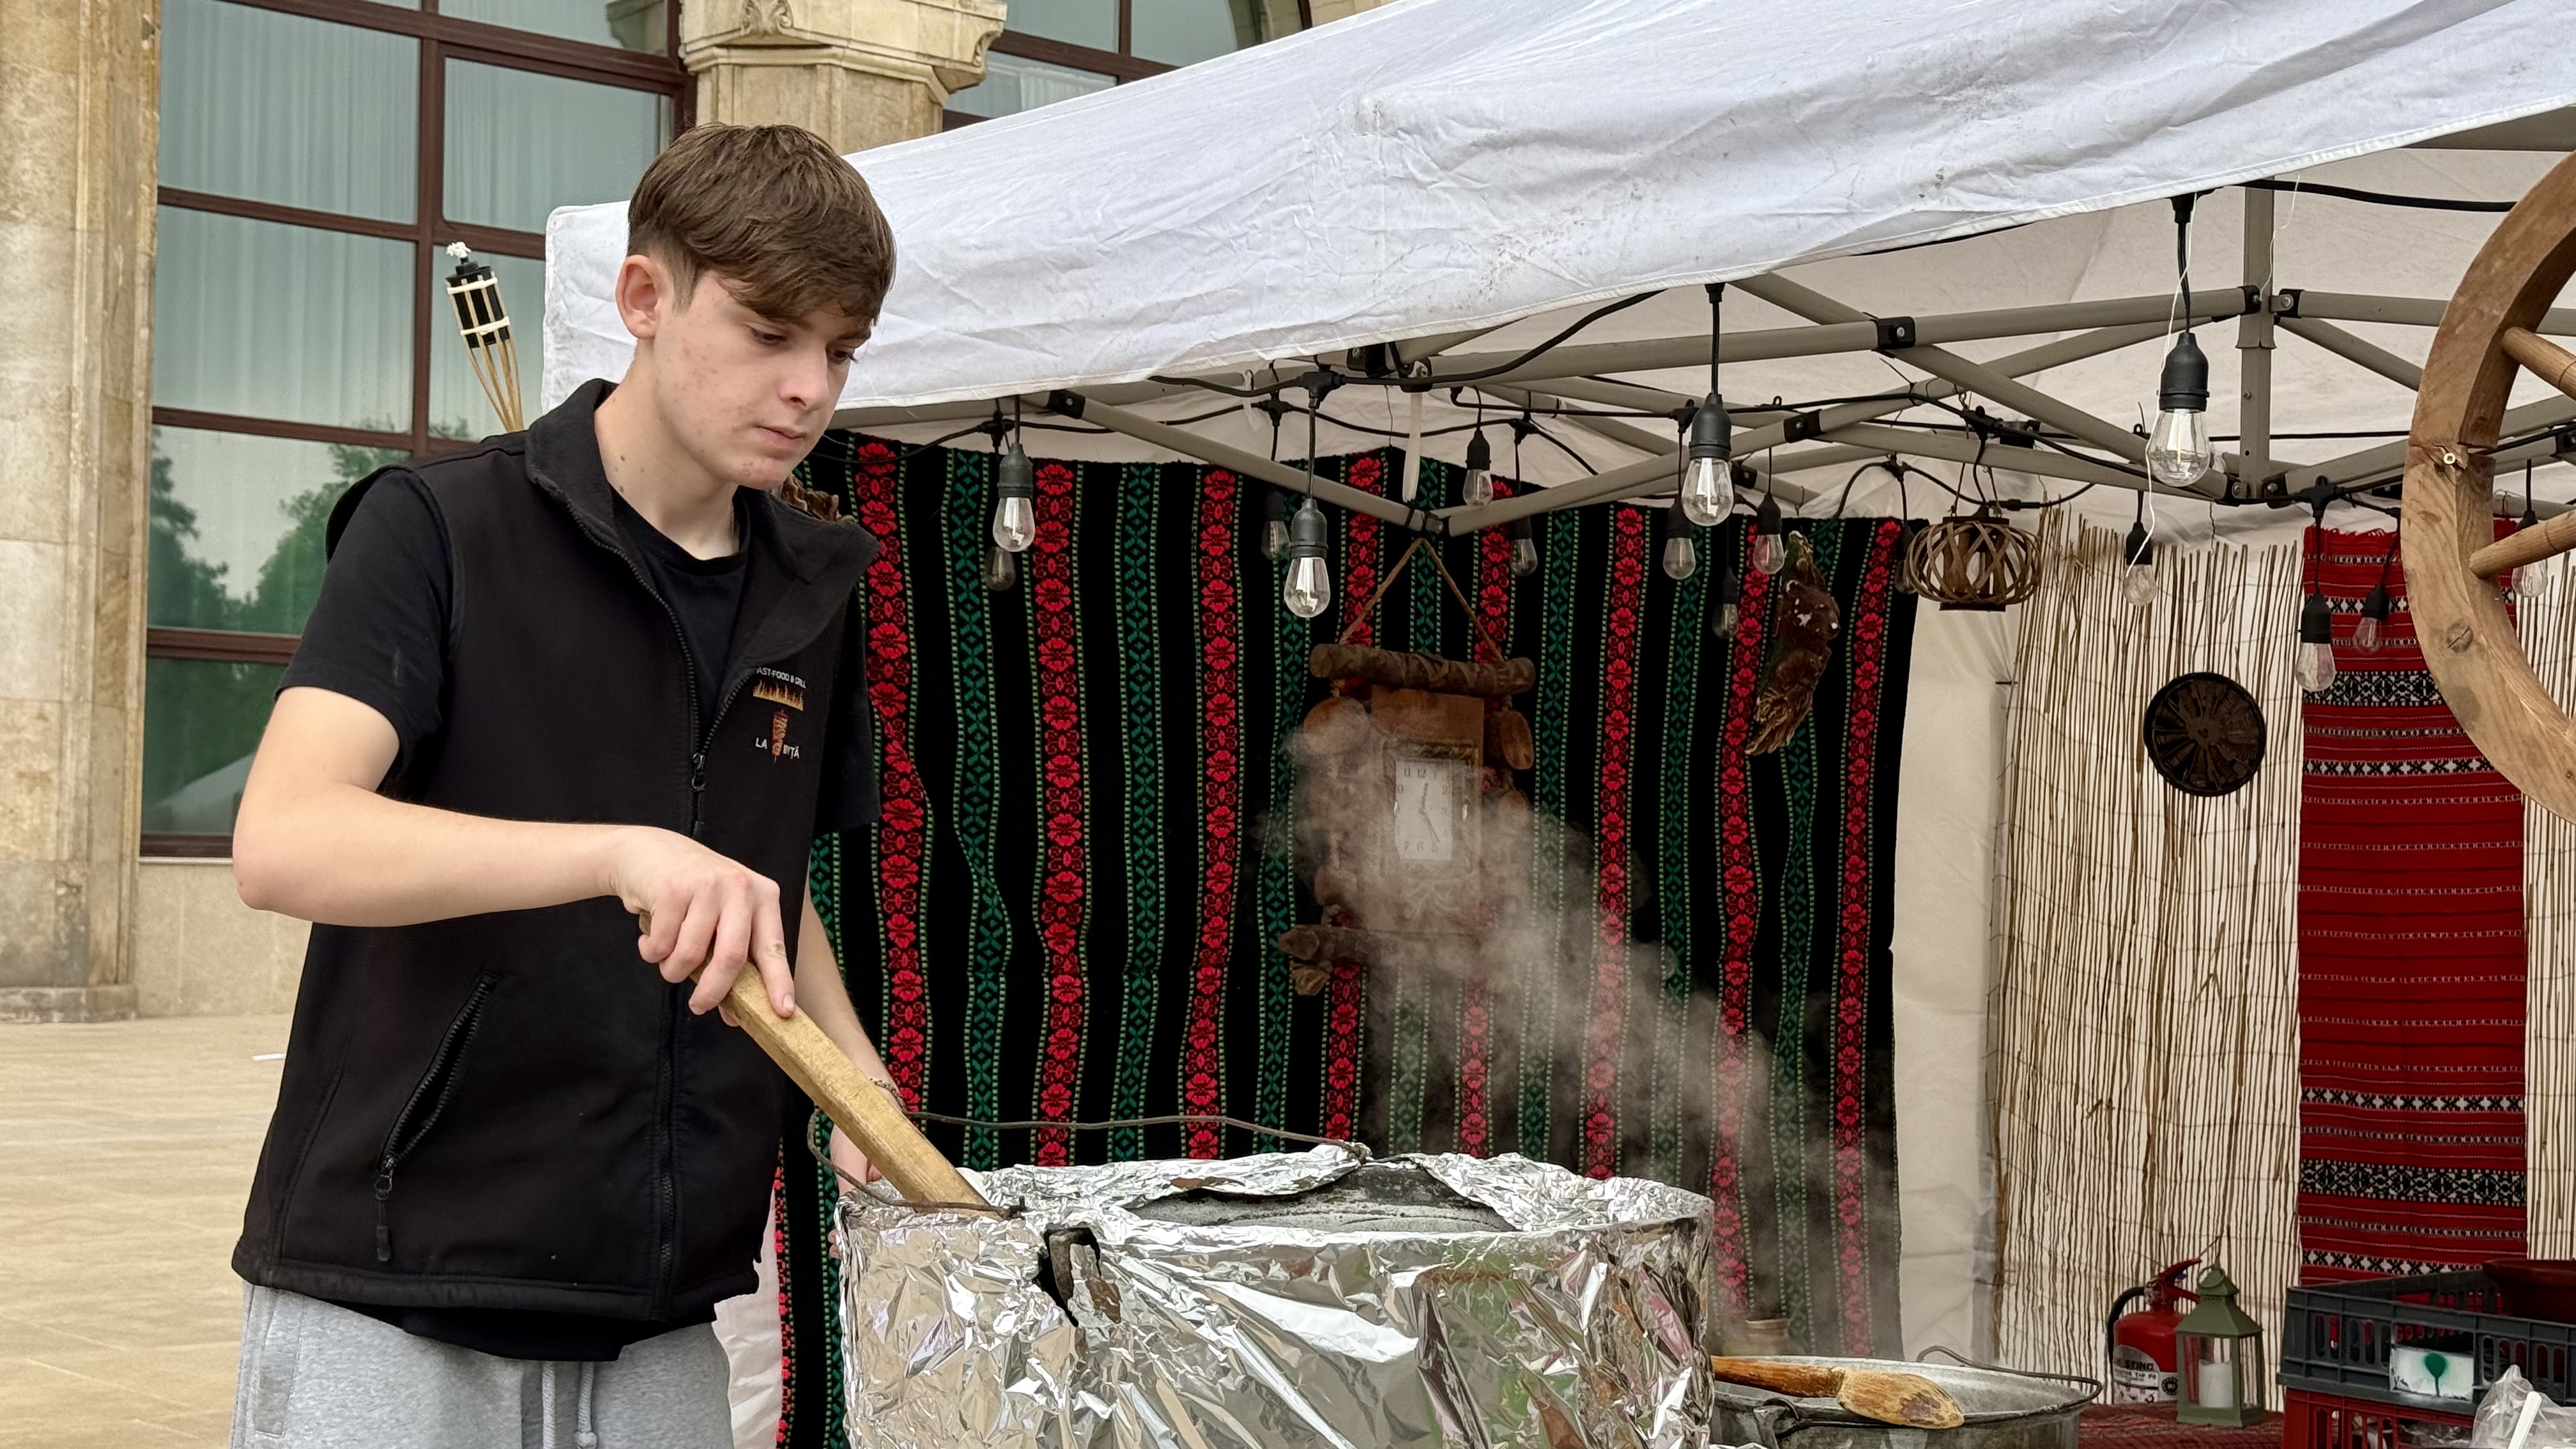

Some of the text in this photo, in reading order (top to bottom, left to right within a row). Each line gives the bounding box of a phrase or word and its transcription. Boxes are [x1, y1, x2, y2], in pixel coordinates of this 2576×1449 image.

[755, 666, 790, 682] AST-FOOD
[755, 737, 768, 749] LA
[1403, 767, 1411, 778] 11
[1416, 768, 1427, 779] 12
